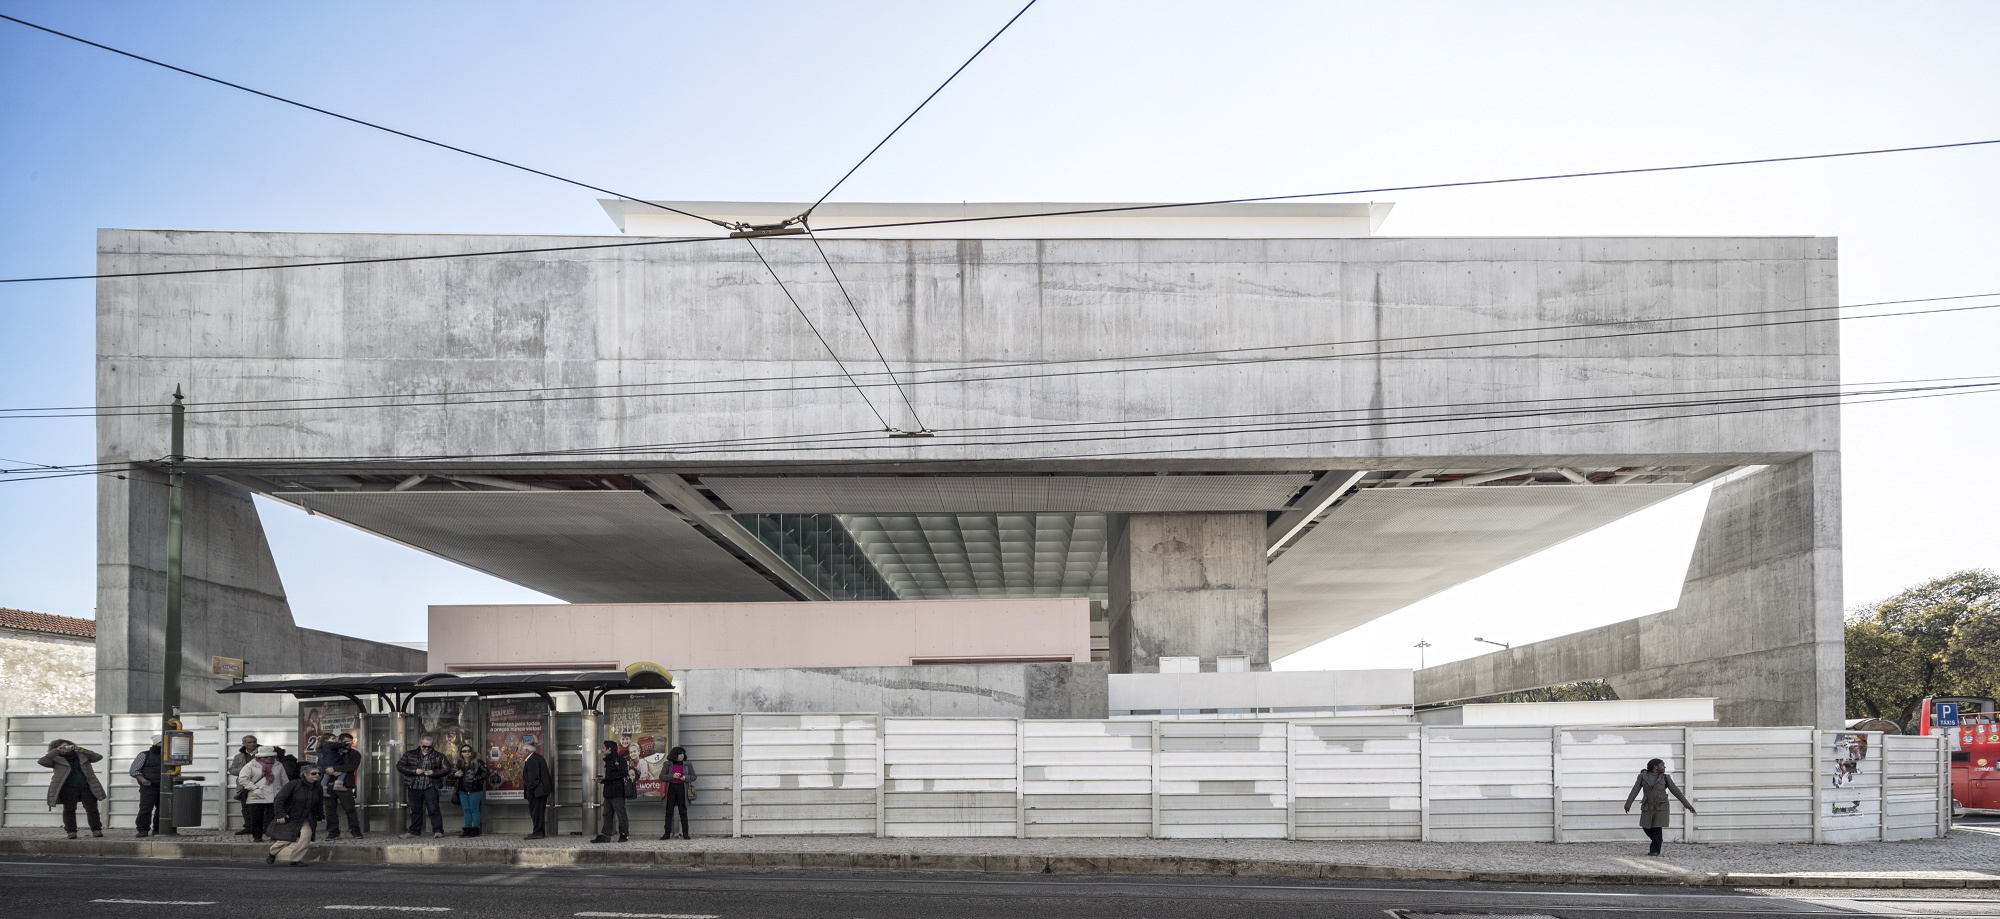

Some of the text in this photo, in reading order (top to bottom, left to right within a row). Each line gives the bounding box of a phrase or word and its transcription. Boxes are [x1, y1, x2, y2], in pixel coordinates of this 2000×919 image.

[491, 709, 515, 717] STAPLES
[1943, 705, 1951, 719] P
[639, 781, 661, 789] worte
